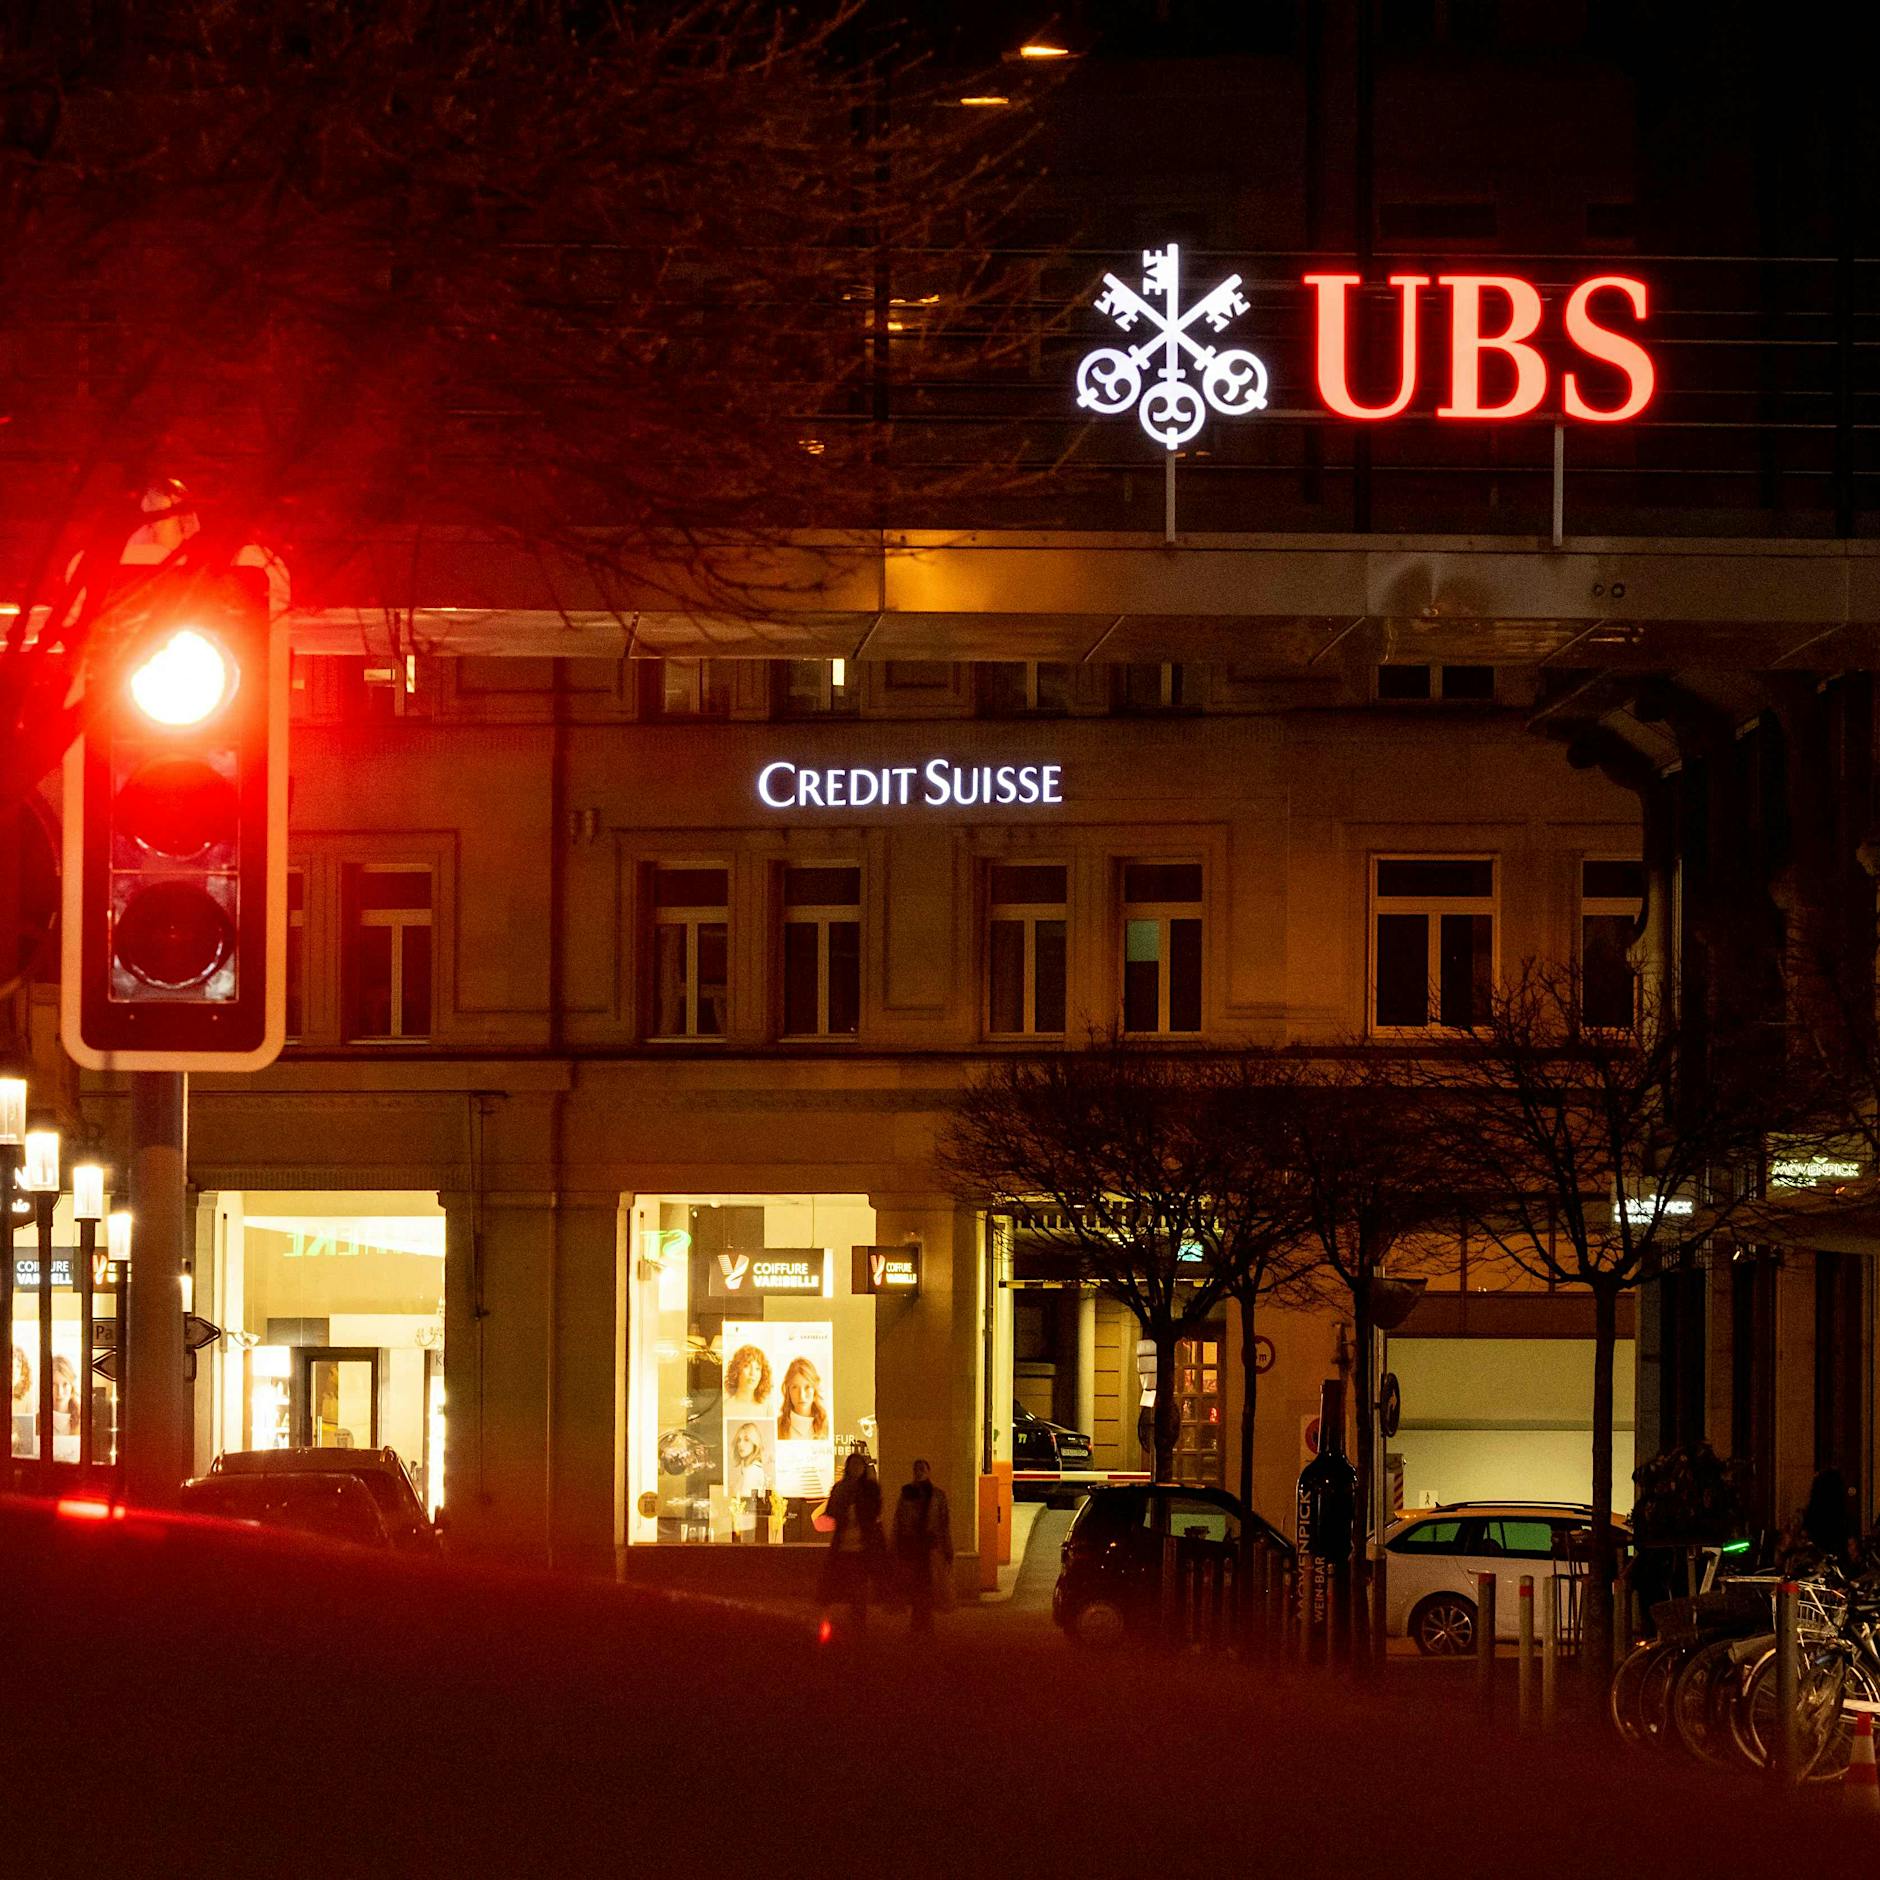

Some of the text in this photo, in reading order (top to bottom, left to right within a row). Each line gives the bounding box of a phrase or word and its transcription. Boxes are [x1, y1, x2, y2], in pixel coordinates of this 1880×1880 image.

[1304, 274, 1655, 421] UBS
[758, 758, 1063, 807] CREDIT SUISSE
[753, 1263, 809, 1275] COIFFURE
[753, 1275, 820, 1288] VARIBELLE
[1313, 1556, 1326, 1623] WEIN-BAR
